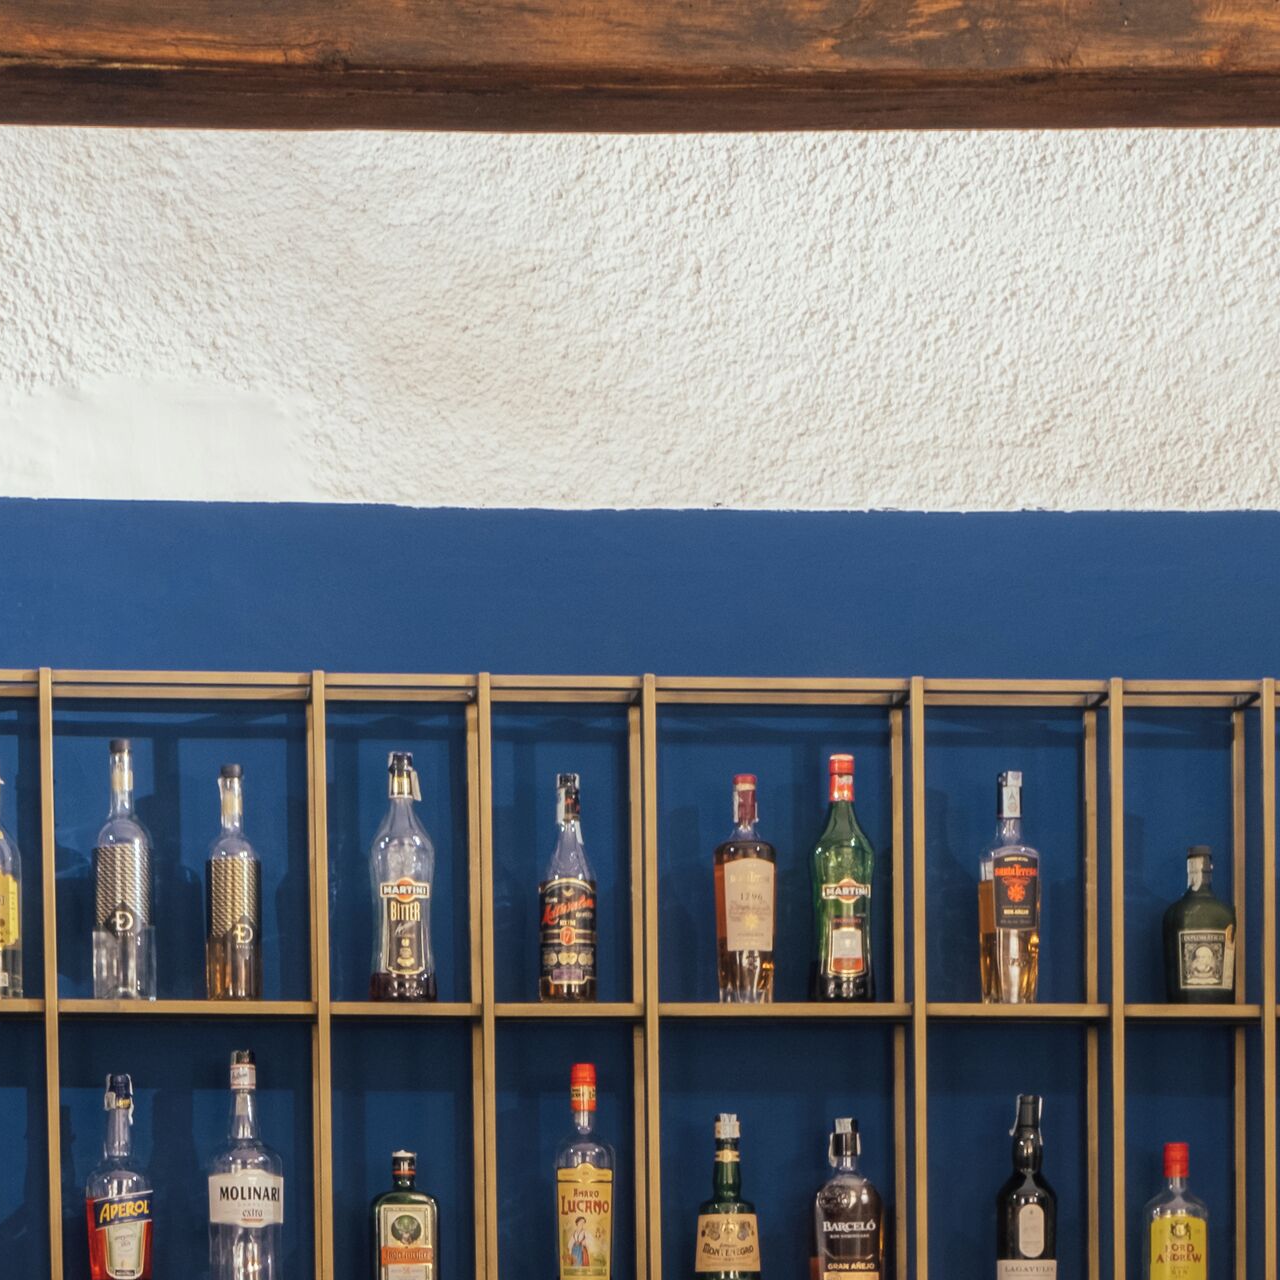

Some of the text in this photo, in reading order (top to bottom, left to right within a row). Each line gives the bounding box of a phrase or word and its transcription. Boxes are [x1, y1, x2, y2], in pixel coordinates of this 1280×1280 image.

[383, 885, 426, 895] MARTINI
[390, 901, 421, 921] BITTER
[219, 1185, 280, 1202] MOLINARI
[99, 1199, 149, 1223] APEROL
[823, 1218, 876, 1233] BARCELÓ
